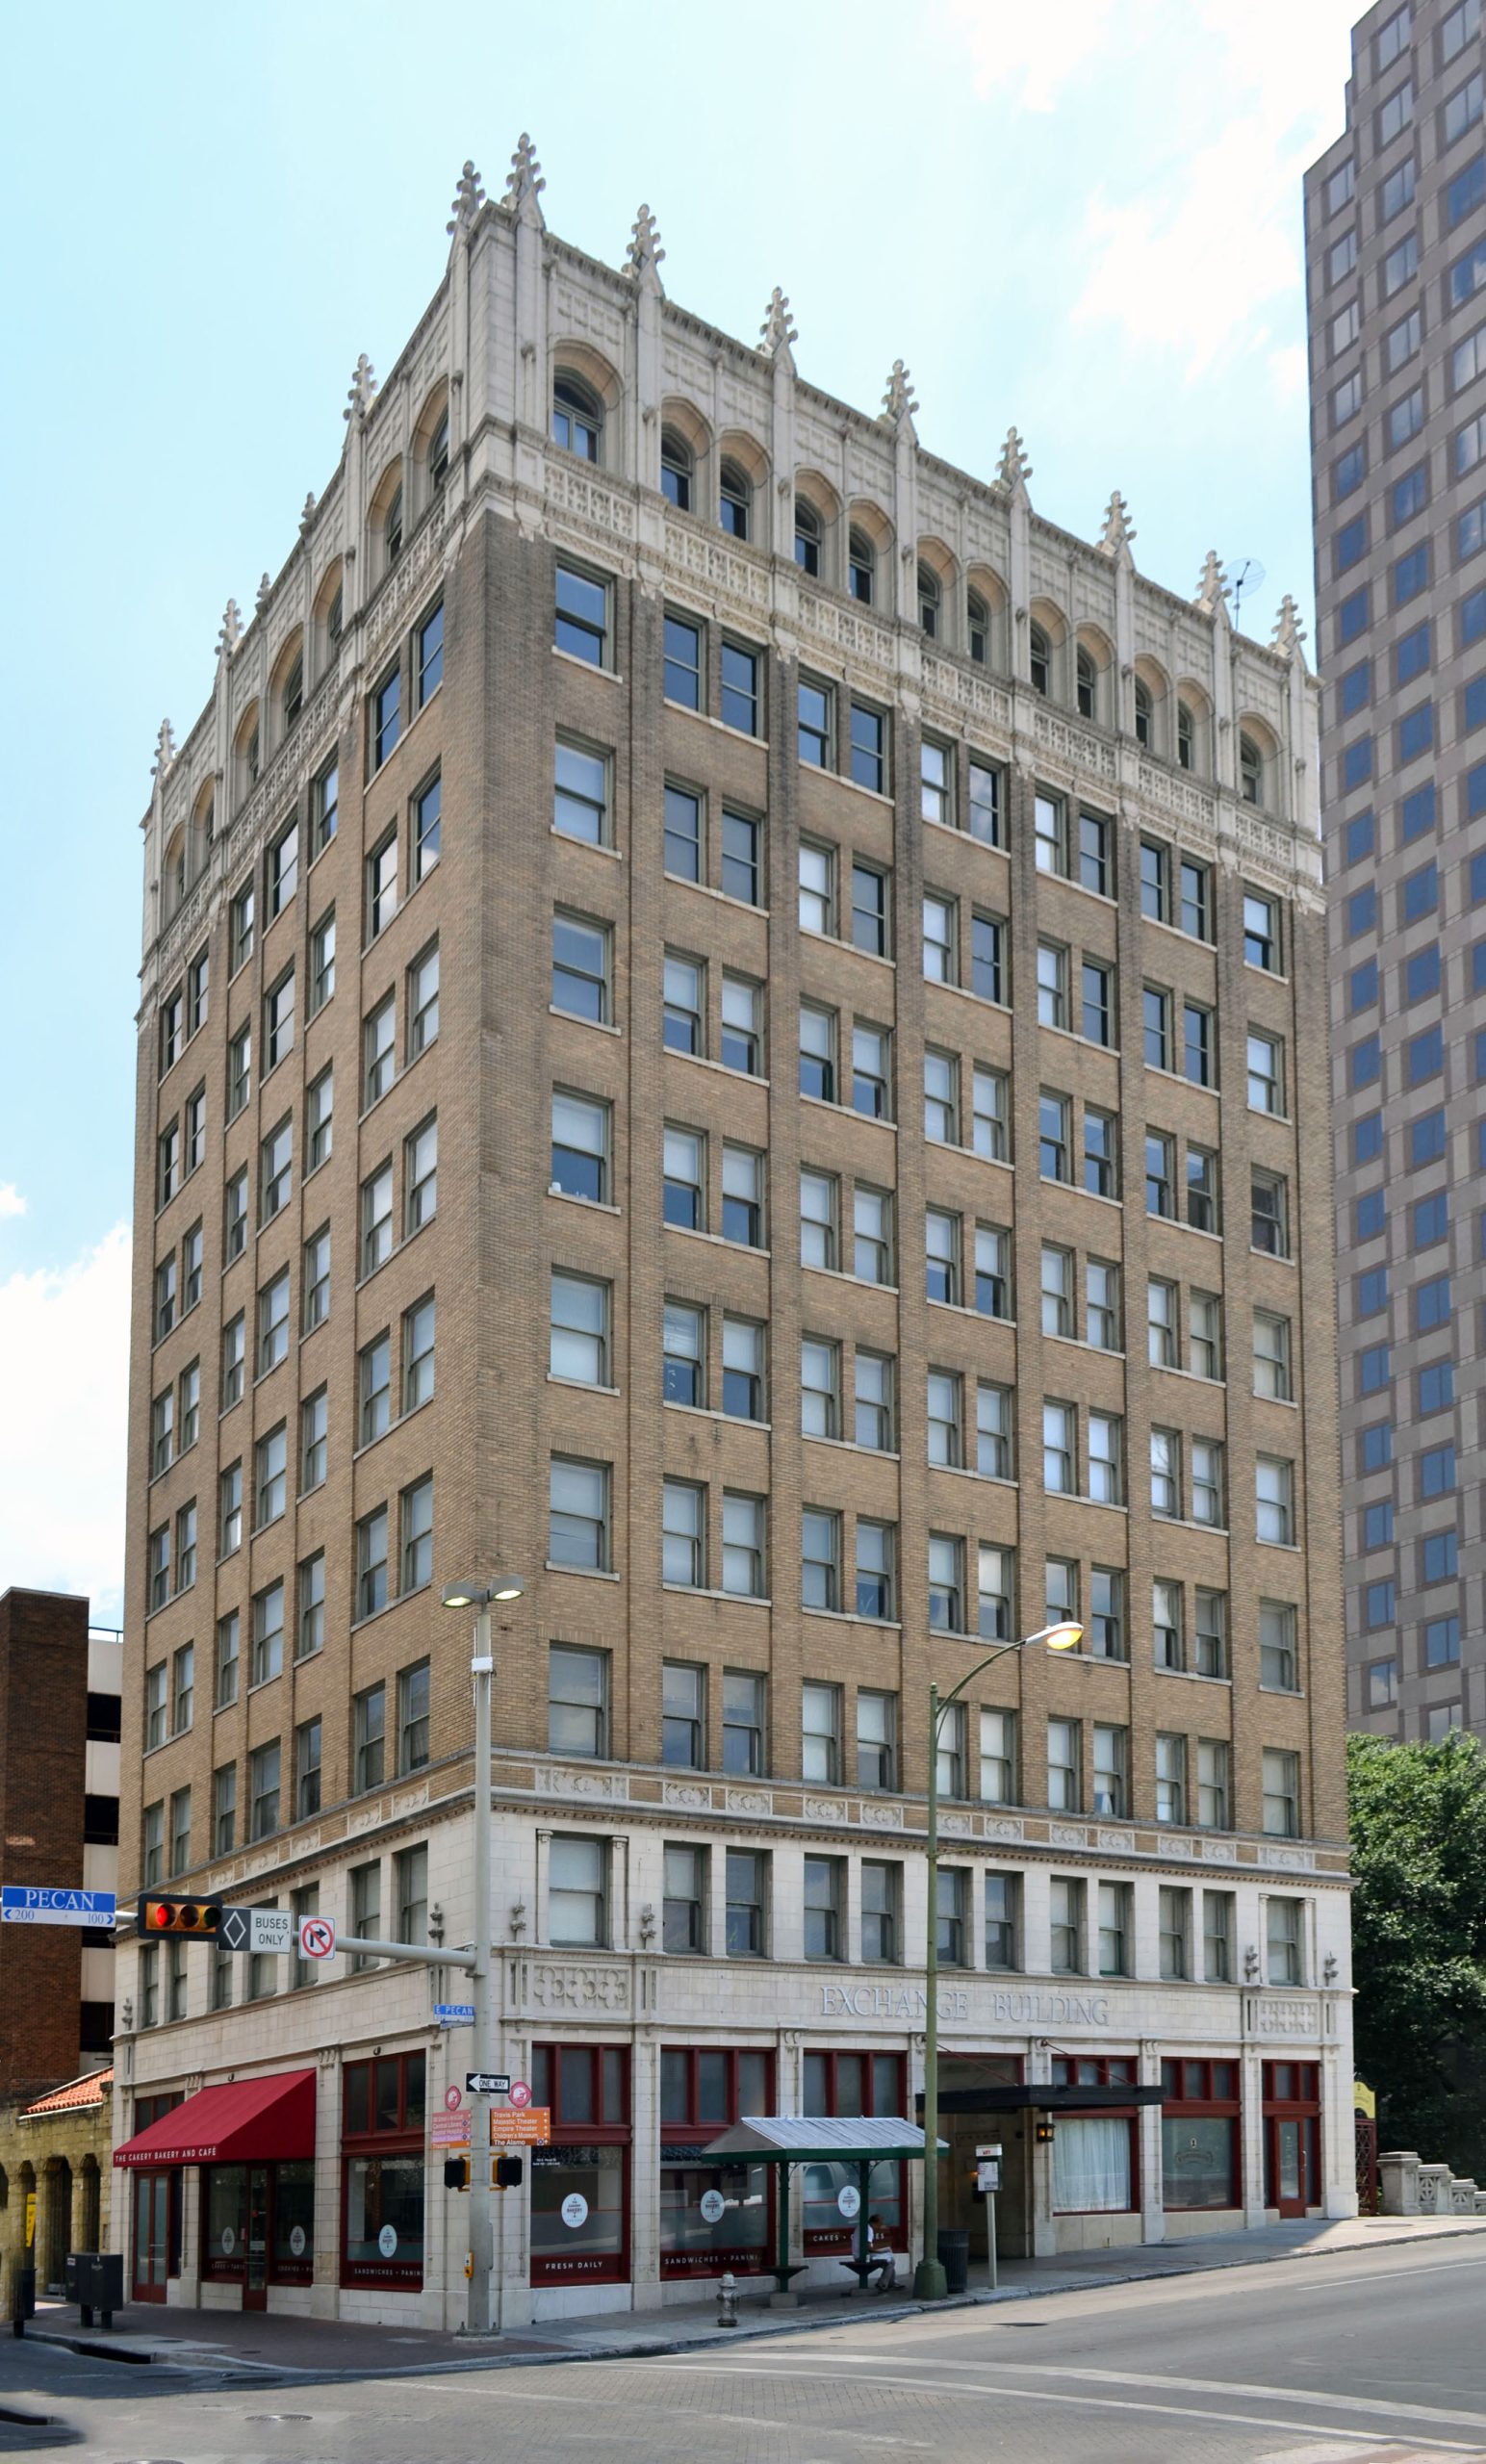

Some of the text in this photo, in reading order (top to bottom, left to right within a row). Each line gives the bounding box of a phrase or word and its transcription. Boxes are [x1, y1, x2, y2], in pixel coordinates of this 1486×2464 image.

[24, 1889, 95, 1911] PECAN
[14, 1910, 104, 1924] 200 100
[255, 1917, 288, 1929] BUSES
[258, 1934, 284, 1945] ONLY
[436, 2005, 473, 2015] E PECAN
[819, 1987, 1109, 2026] EXCHANGE BUILDING
[478, 2079, 505, 2089] ONE WAY
[128, 2152, 152, 2162] CAKERY
[154, 2150, 179, 2160] BAKERY
[182, 2148, 196, 2158] AND
[198, 2145, 217, 2157] CAFÉ
[664, 2255, 719, 2265] SANDWICHES
